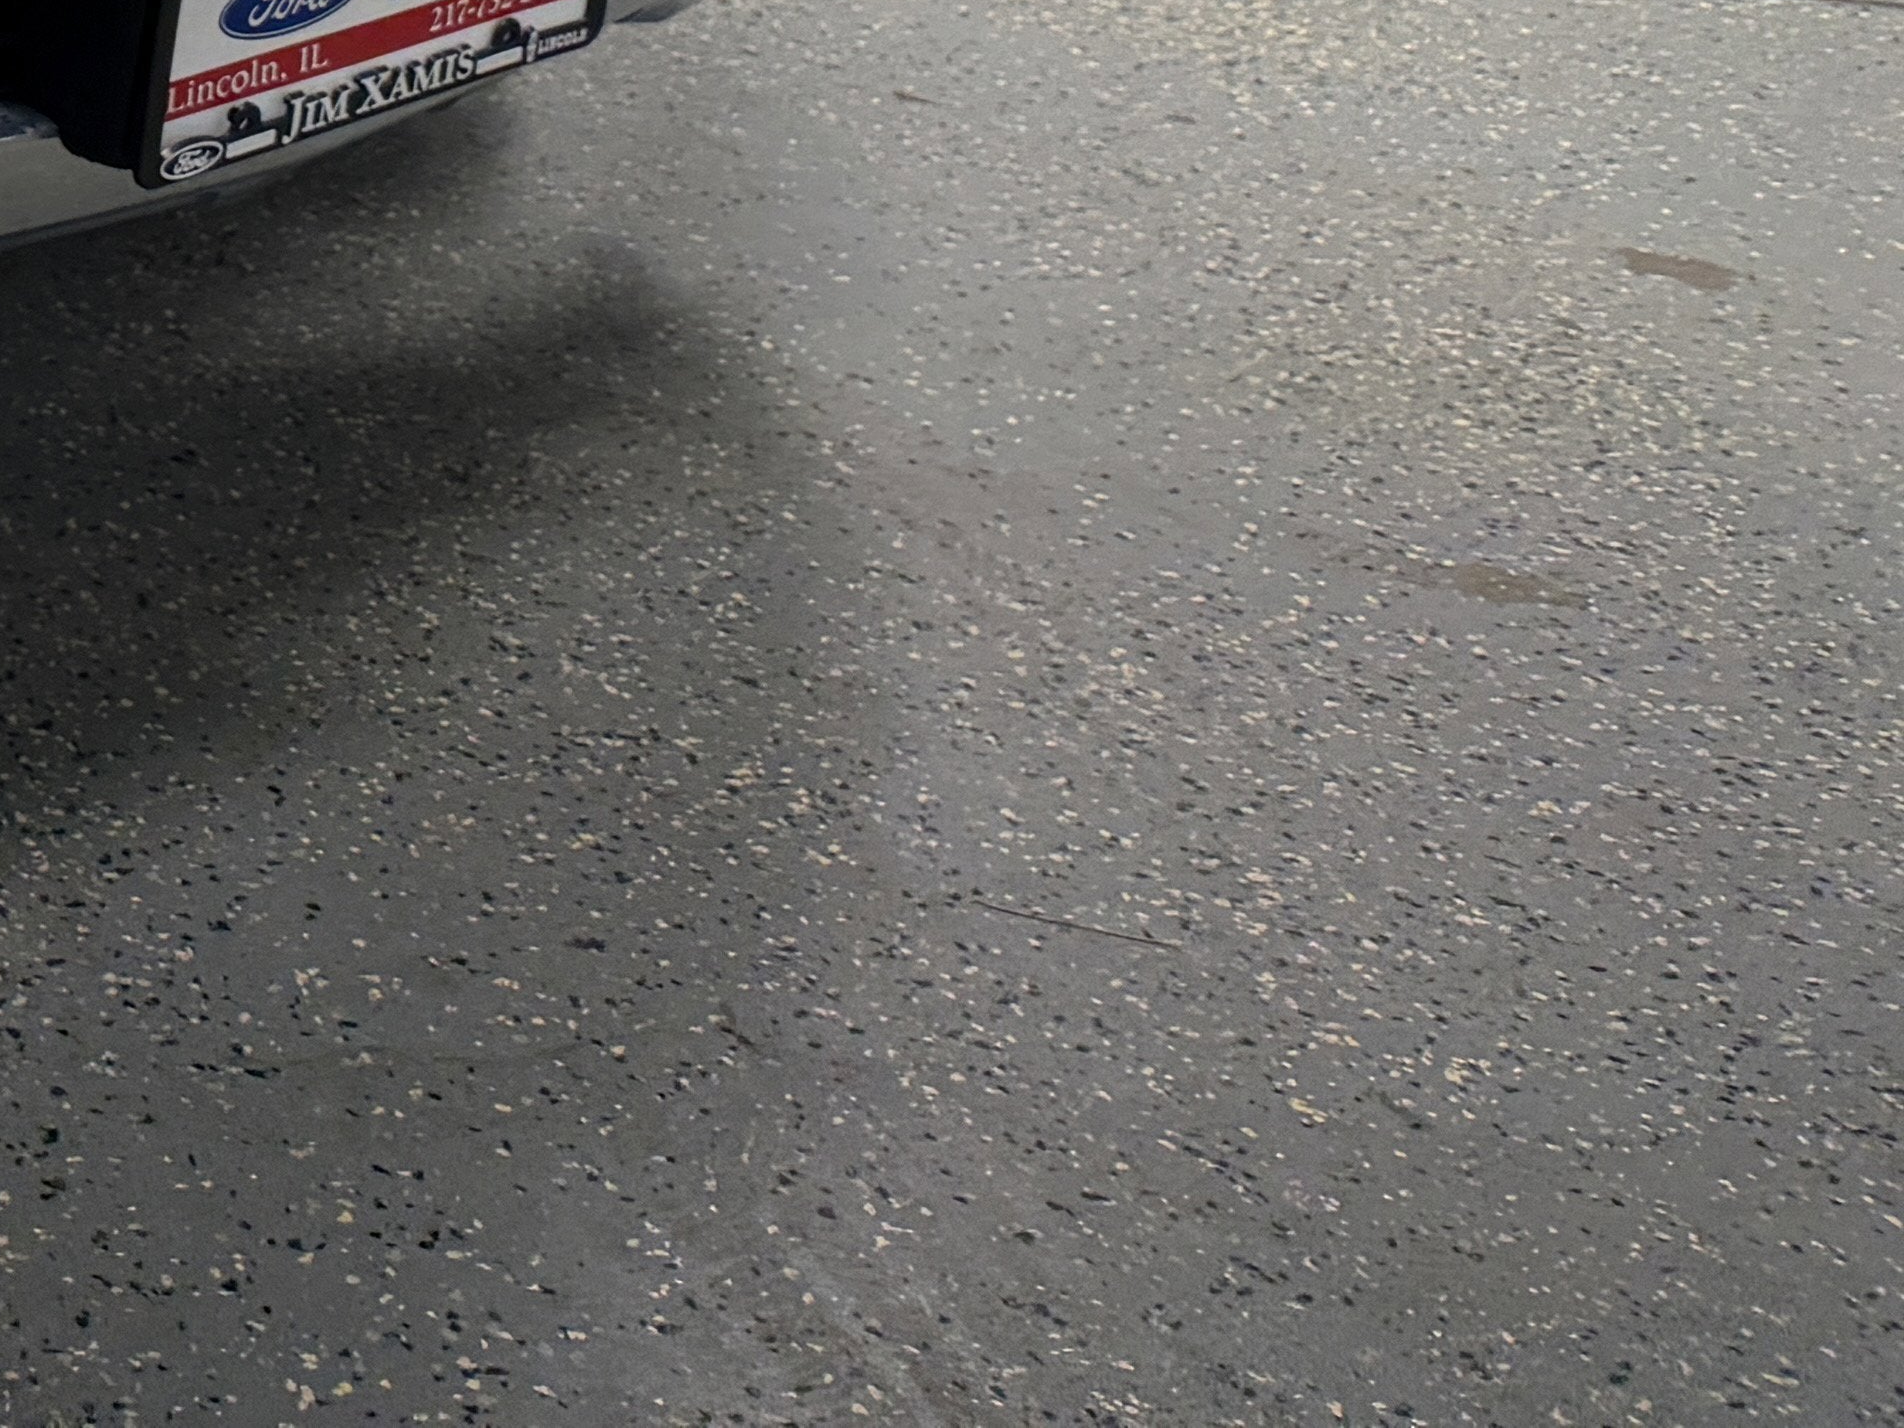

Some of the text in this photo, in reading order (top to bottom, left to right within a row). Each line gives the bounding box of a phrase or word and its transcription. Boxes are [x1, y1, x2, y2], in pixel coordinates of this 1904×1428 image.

[166, 43, 329, 114] Lincoln, IL
[281, 45, 476, 145] JIM XAMIS
[173, 148, 210, 176] Ford
